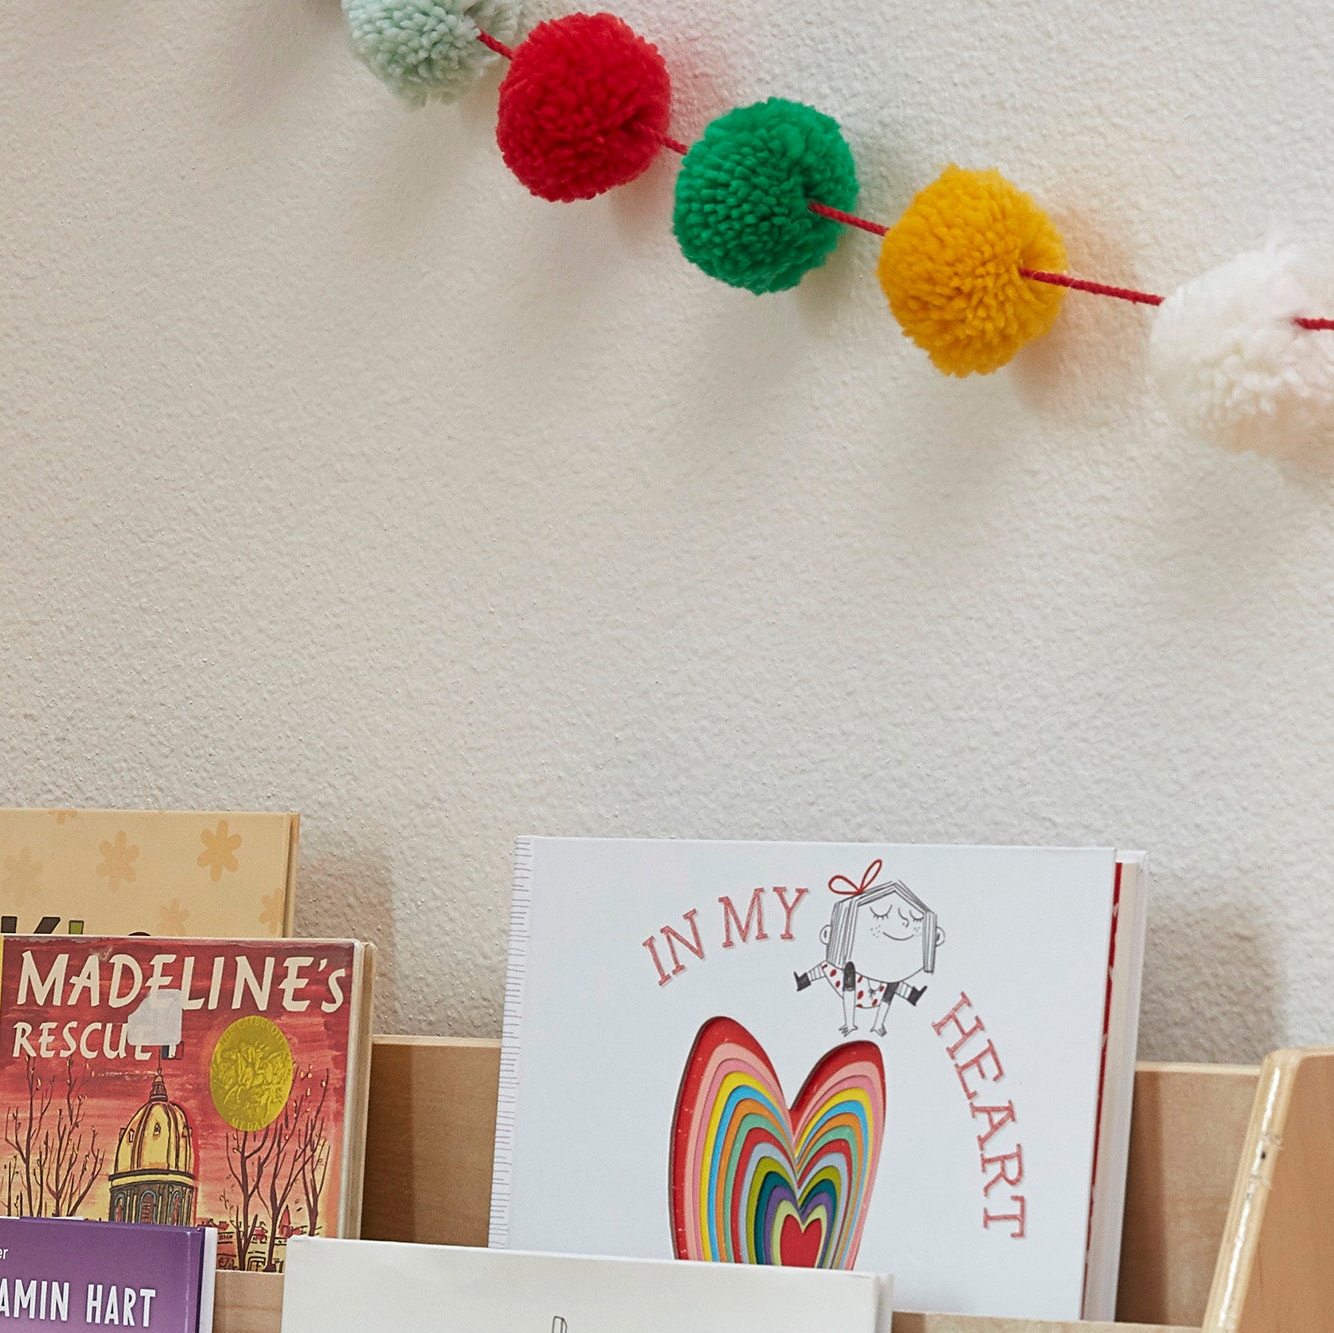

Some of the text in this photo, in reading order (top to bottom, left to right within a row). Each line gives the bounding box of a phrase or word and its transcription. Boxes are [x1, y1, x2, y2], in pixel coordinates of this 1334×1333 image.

[642, 886, 808, 987] IN MY
[16, 950, 345, 1013] MADELINE'S
[931, 991, 1025, 1239] HEART
[86, 1284, 156, 1327] HART
